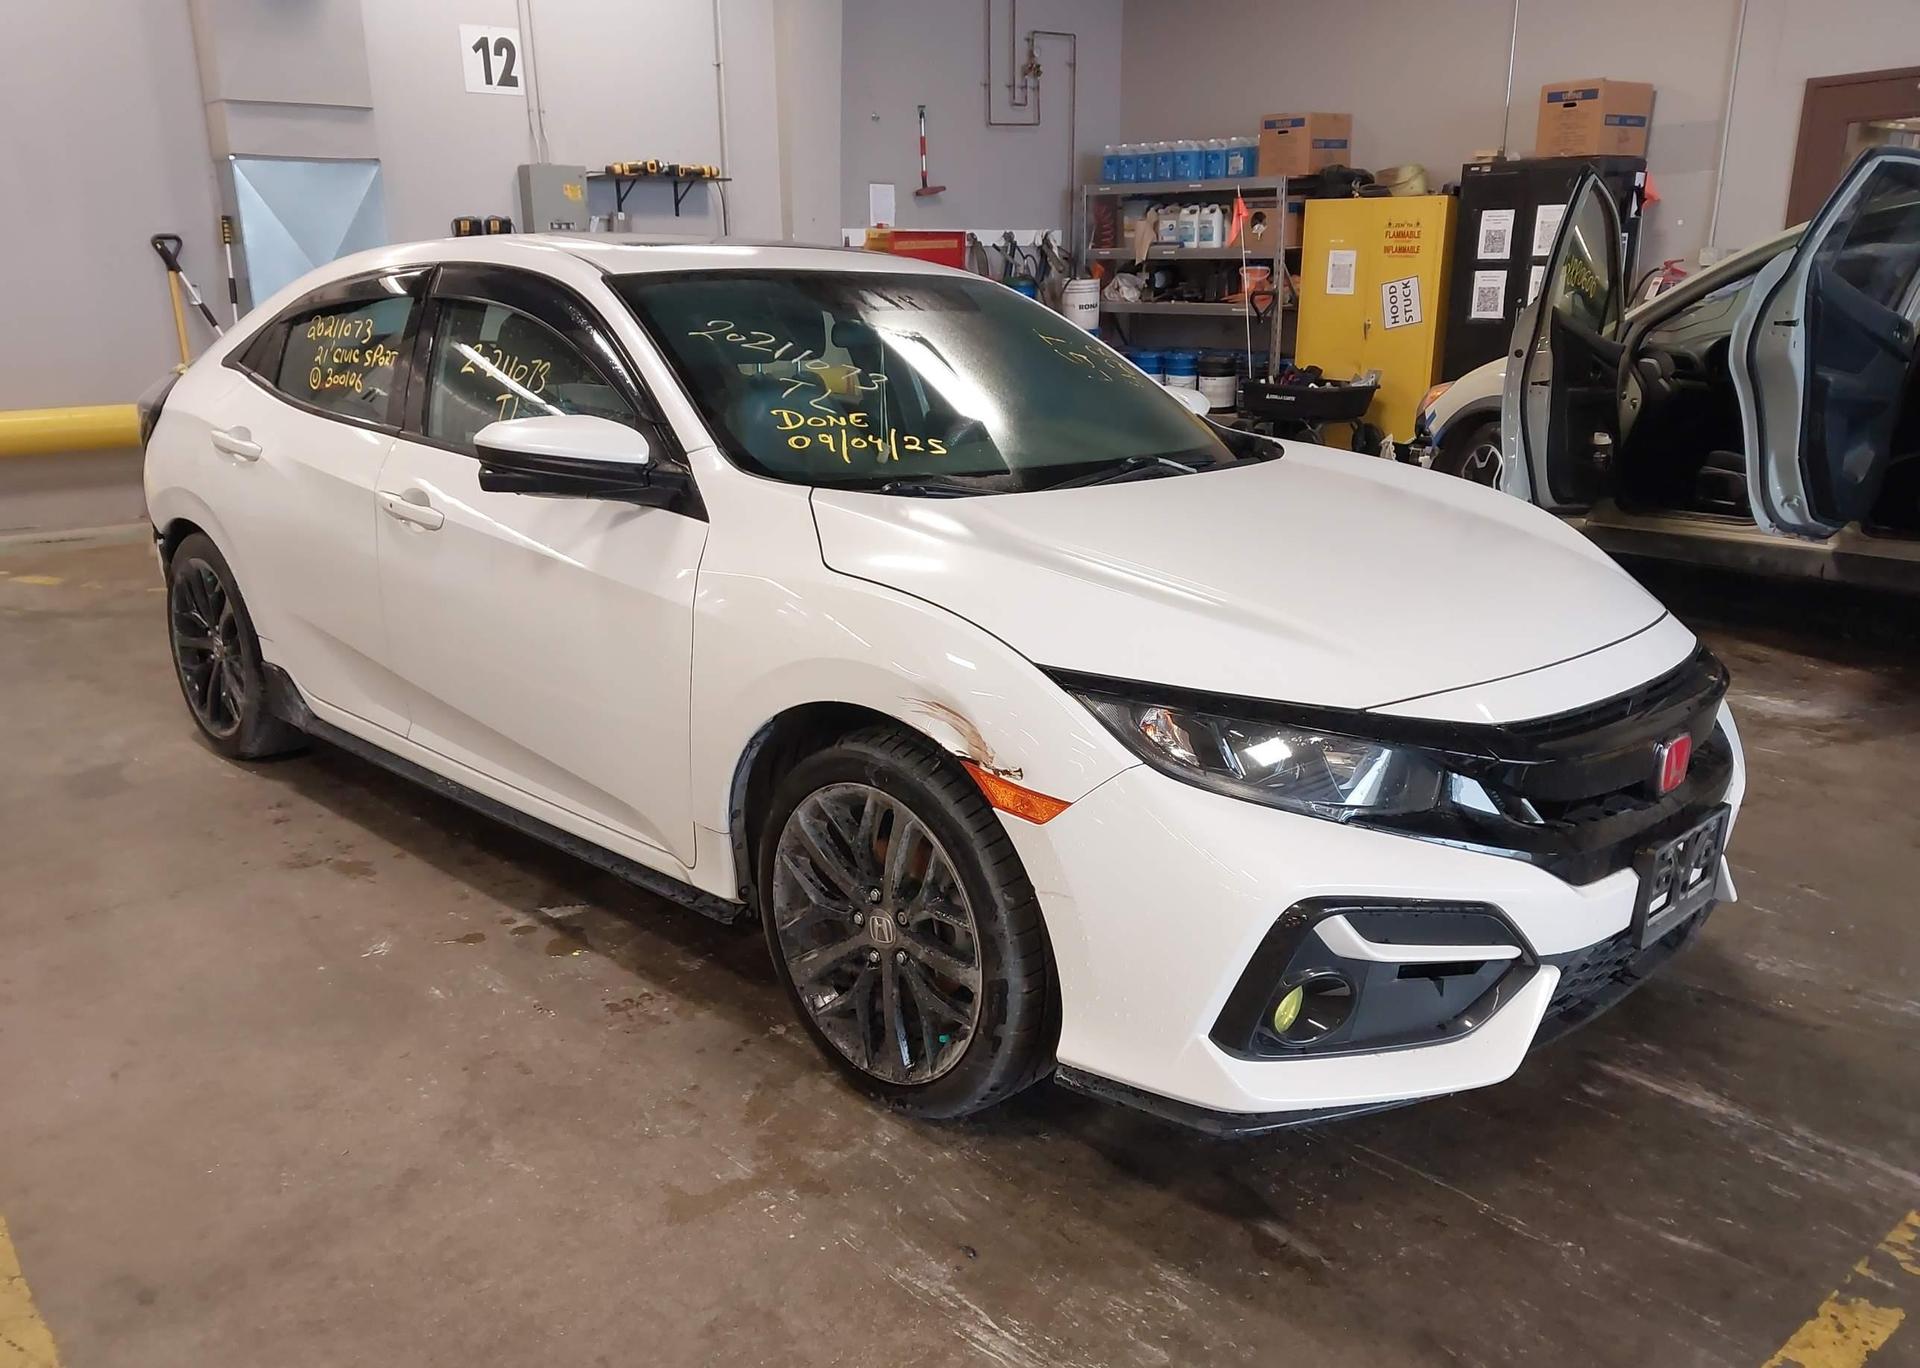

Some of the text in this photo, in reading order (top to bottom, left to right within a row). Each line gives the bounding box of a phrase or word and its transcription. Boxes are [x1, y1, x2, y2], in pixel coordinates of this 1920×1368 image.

[472, 36, 519, 87] 12
[1383, 245, 1421, 254] INFLAMMABLE
[1385, 230, 1421, 239] FLAMMABLE
[1388, 285, 1400, 325] HOOD
[1401, 280, 1414, 323] STUCK
[307, 314, 374, 344] 20211073
[363, 343, 399, 368] SPORT
[688, 319, 889, 391] 20211073
[325, 367, 363, 394] 300106
[779, 377, 837, 414] T2
[770, 409, 869, 430] DONE
[787, 428, 949, 464] 09/04/25
